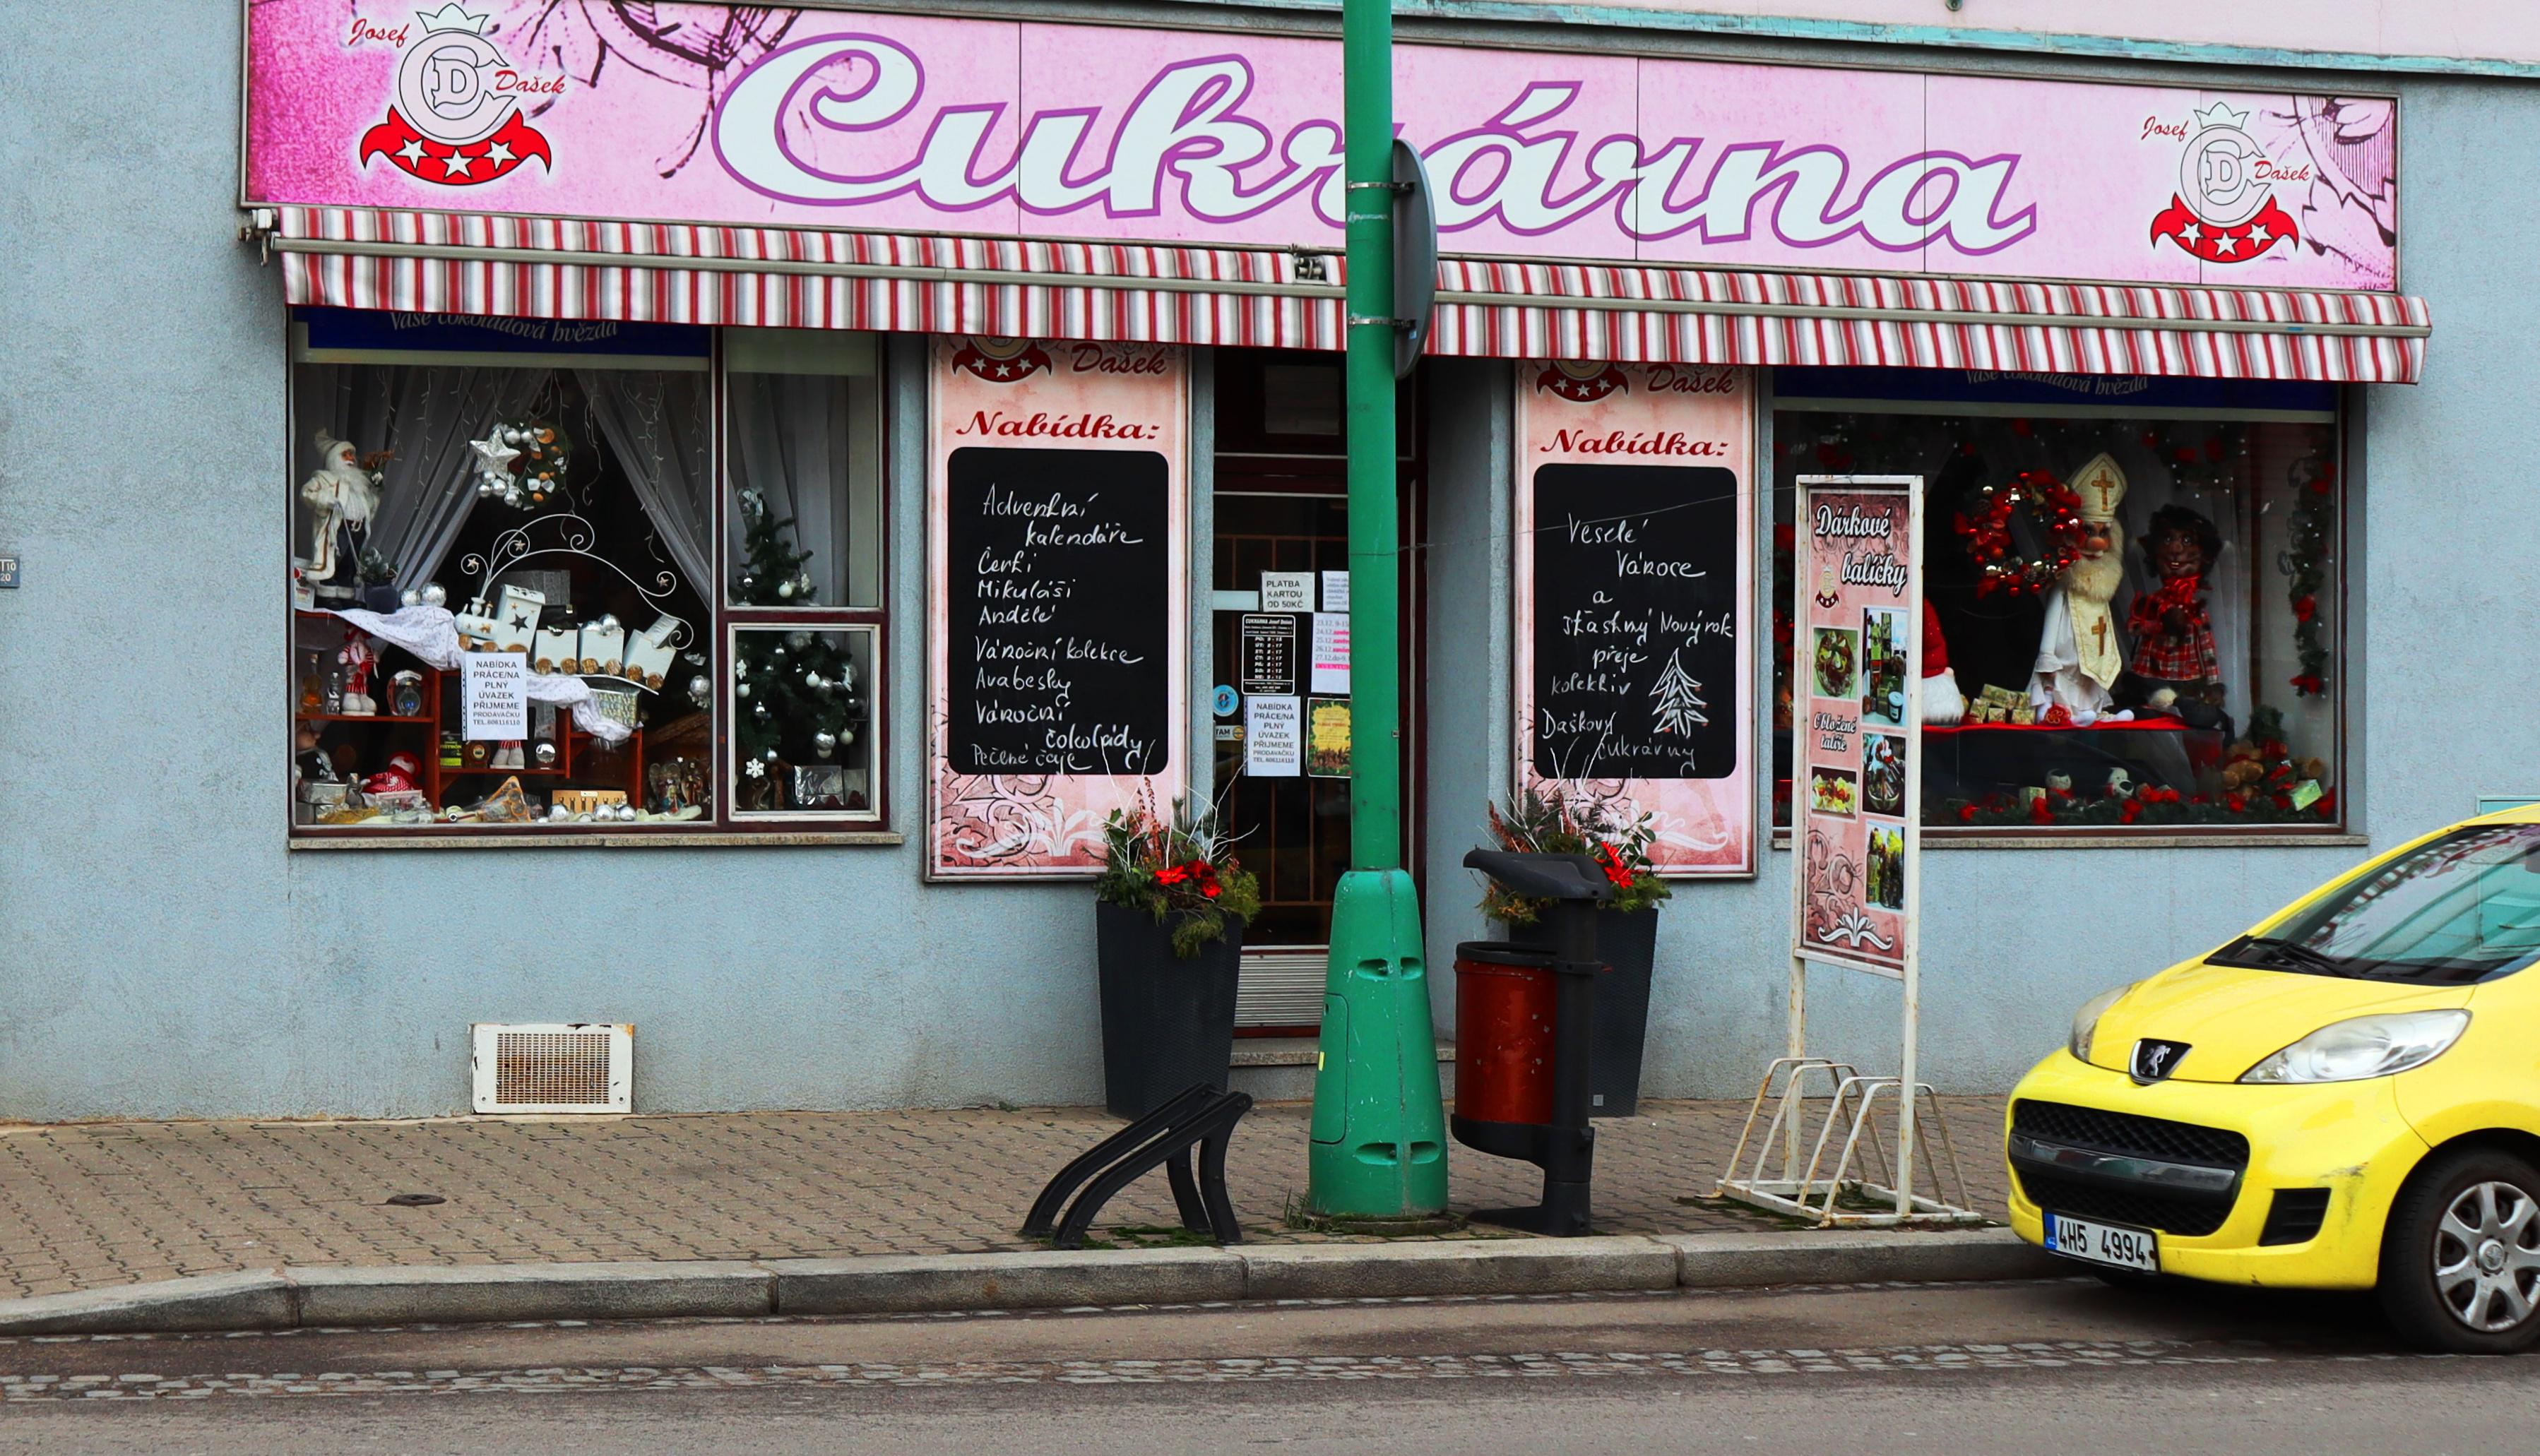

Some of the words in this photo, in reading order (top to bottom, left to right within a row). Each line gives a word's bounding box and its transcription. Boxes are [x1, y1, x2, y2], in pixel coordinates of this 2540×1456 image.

[348, 18, 411, 49] Josef
[494, 69, 566, 95] Dašek
[2141, 115, 2190, 143] Josef
[2253, 160, 2310, 182] Dašek
[552, 321, 619, 342] hvězda
[1072, 342, 1168, 375] Dašek
[1646, 364, 1735, 395] Dašek
[955, 410, 1161, 441] Nabídka:
[1540, 429, 1729, 457] Nabídka:
[1815, 504, 1892, 537] Dárkové
[1616, 550, 1707, 578] Vánoce
[1841, 552, 1906, 595] balíčky
[1592, 590, 1614, 604] a
[476, 660, 518, 669] NABÍDKA
[1813, 711, 1858, 734] Obložené
[2058, 1220, 2088, 1253] 4H5
[2101, 1229, 2146, 1265] 4994
